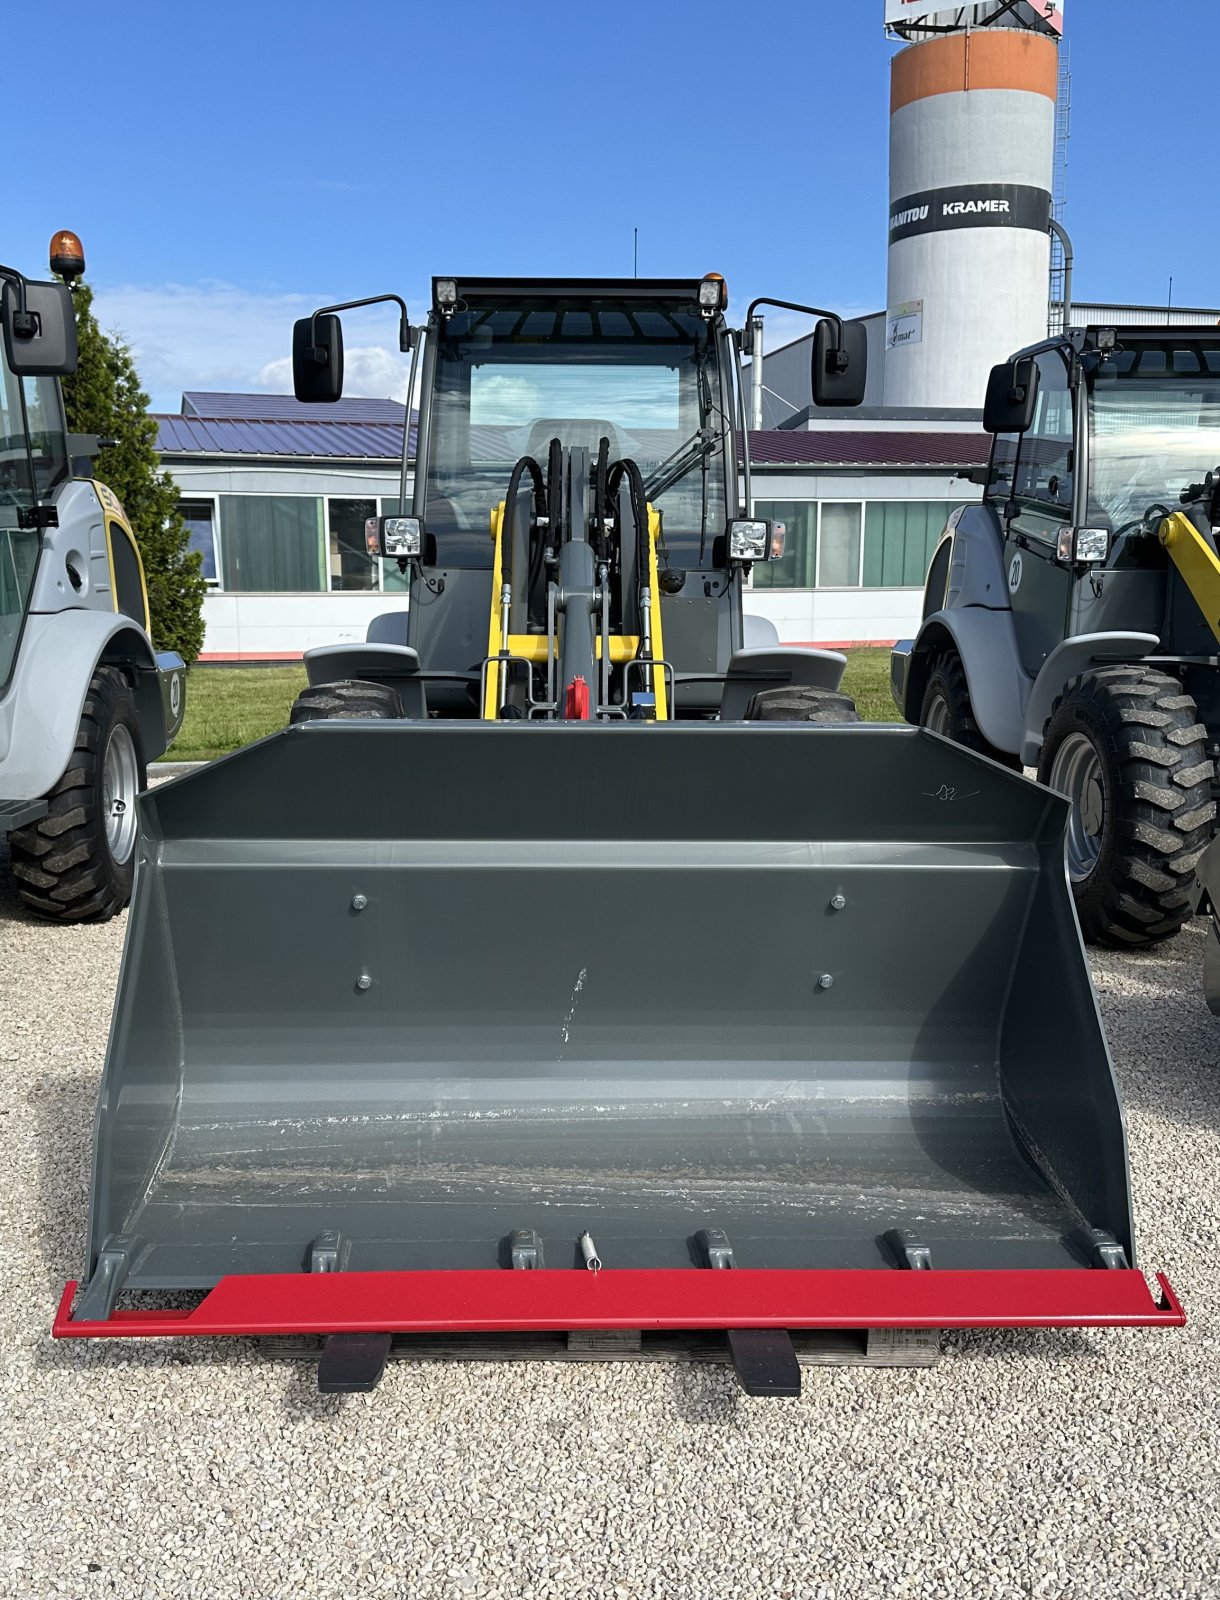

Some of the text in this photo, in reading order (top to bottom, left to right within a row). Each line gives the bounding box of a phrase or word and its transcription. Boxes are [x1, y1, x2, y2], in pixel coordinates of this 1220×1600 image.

[942, 199, 1010, 215] KRAMER
[1010, 559, 1021, 586] 20
[172, 679, 179, 709] 20
